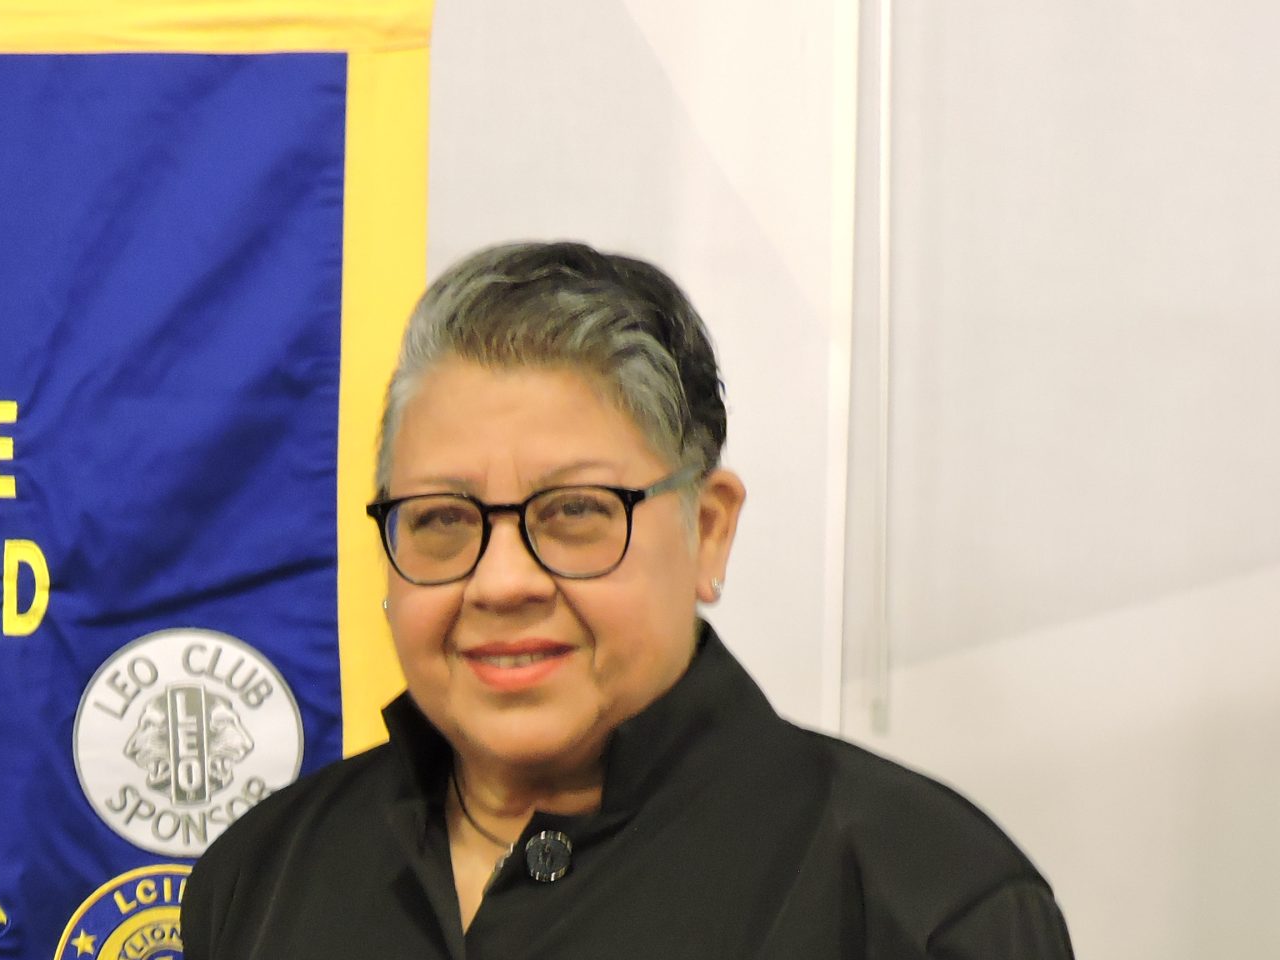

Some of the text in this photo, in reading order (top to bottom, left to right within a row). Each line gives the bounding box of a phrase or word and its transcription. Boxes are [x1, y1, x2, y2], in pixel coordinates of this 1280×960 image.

[93, 644, 274, 721] LEO CLUB
[175, 690, 203, 793] LEO
